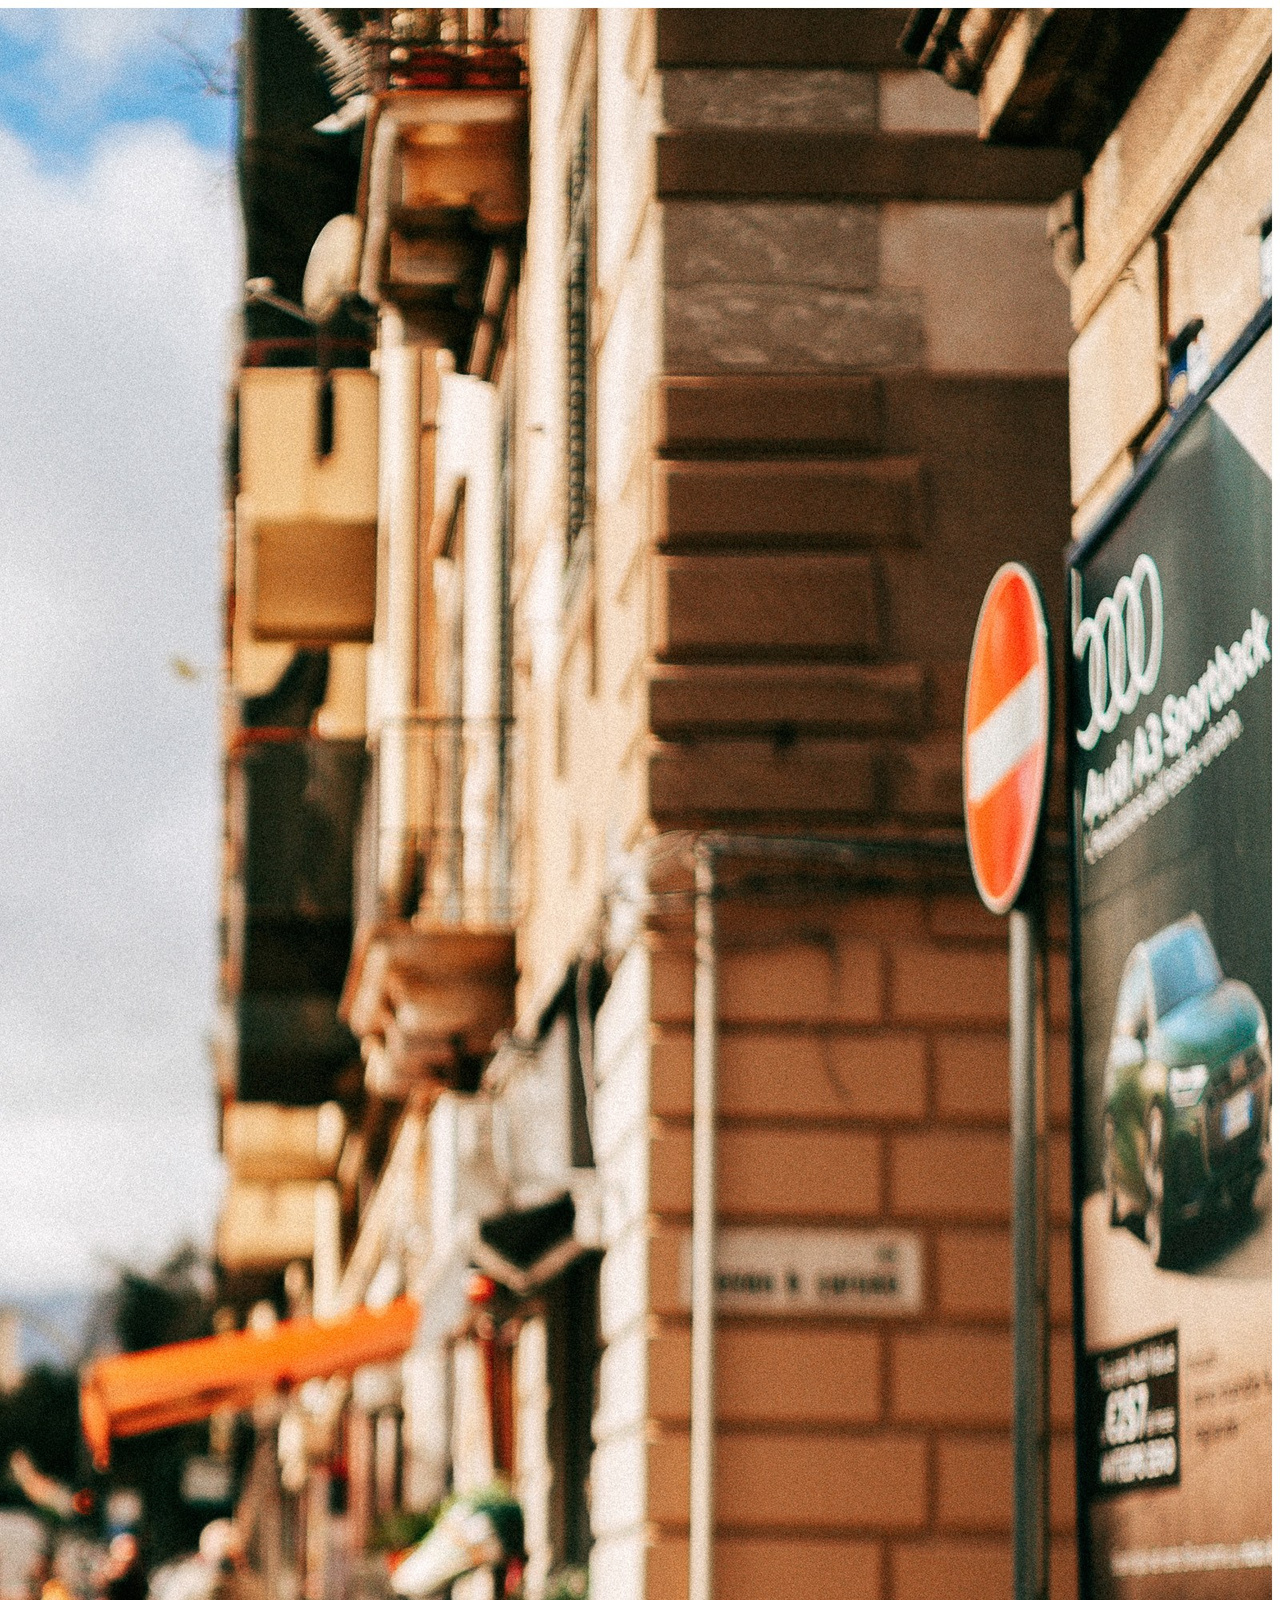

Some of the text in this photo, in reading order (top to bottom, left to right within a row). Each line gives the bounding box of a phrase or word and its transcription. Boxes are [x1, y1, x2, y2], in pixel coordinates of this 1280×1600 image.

[1083, 739, 1133, 827] Audi
[1134, 712, 1163, 788] A3
[1162, 608, 1270, 758] Sportback
